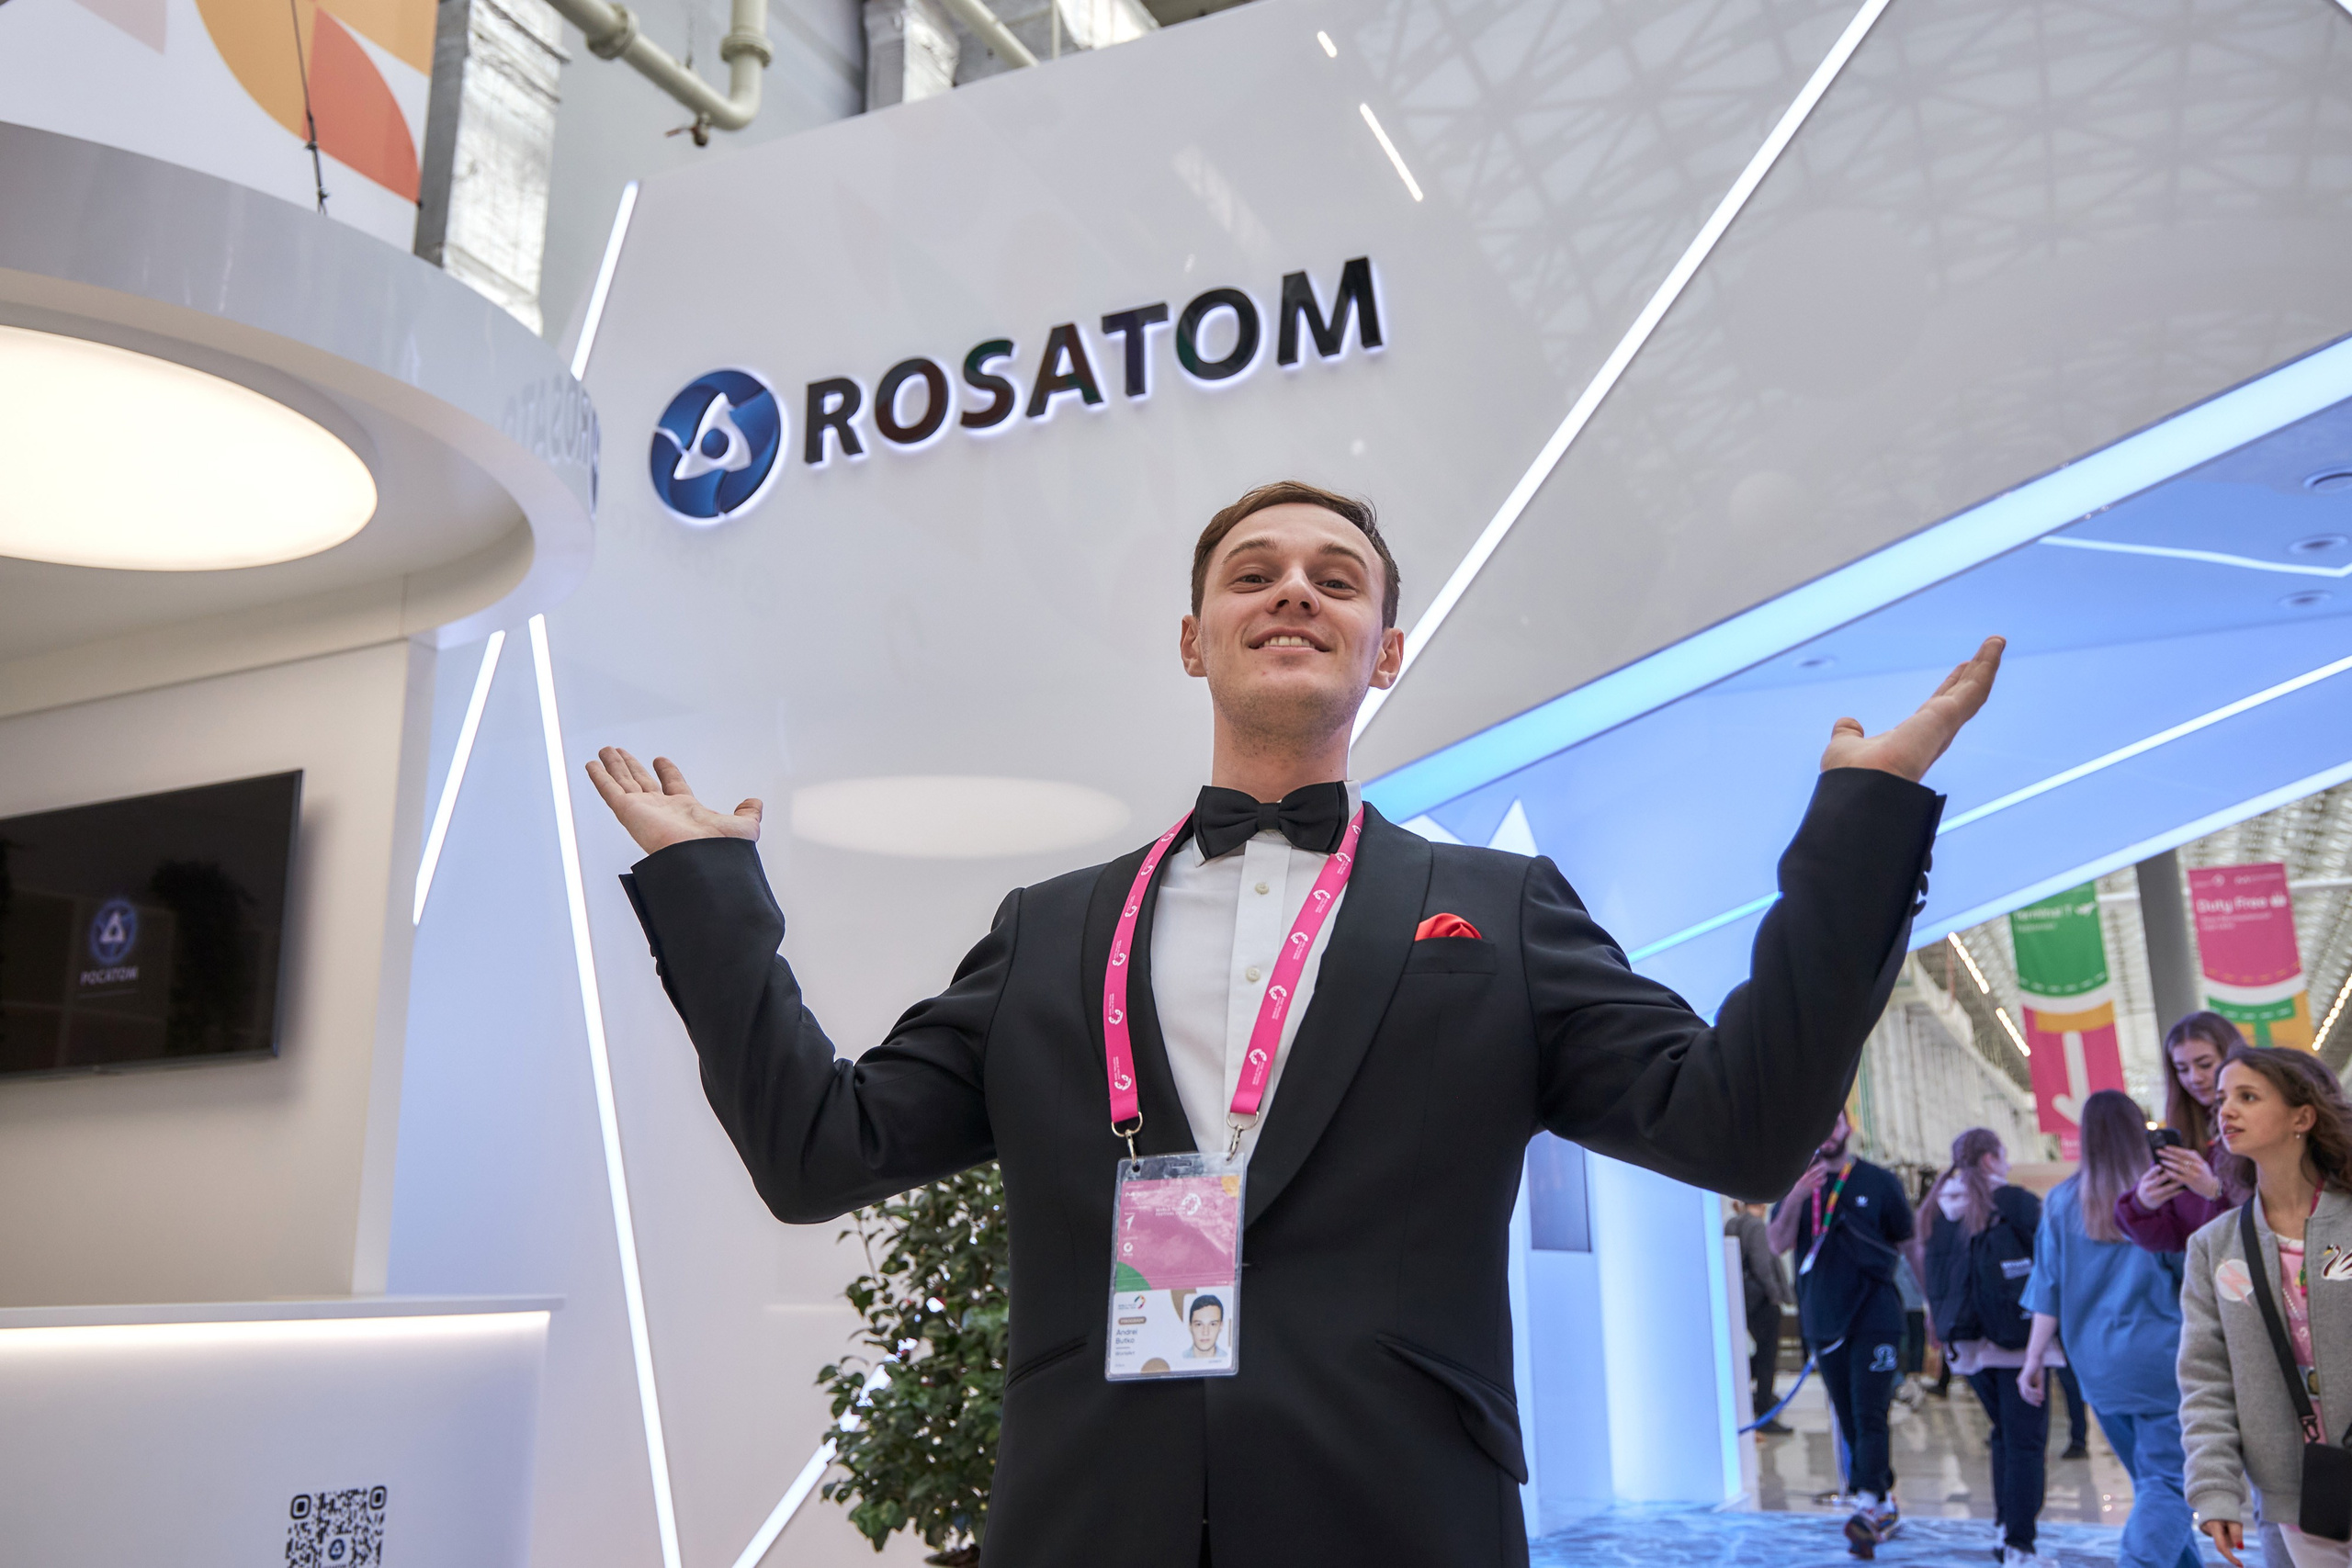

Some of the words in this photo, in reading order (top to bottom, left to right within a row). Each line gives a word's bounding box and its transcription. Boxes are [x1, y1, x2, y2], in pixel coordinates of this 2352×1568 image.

[803, 256, 1382, 465] ROSATOM
[2197, 898, 2233, 915] Duty
[2234, 896, 2268, 909] Free
